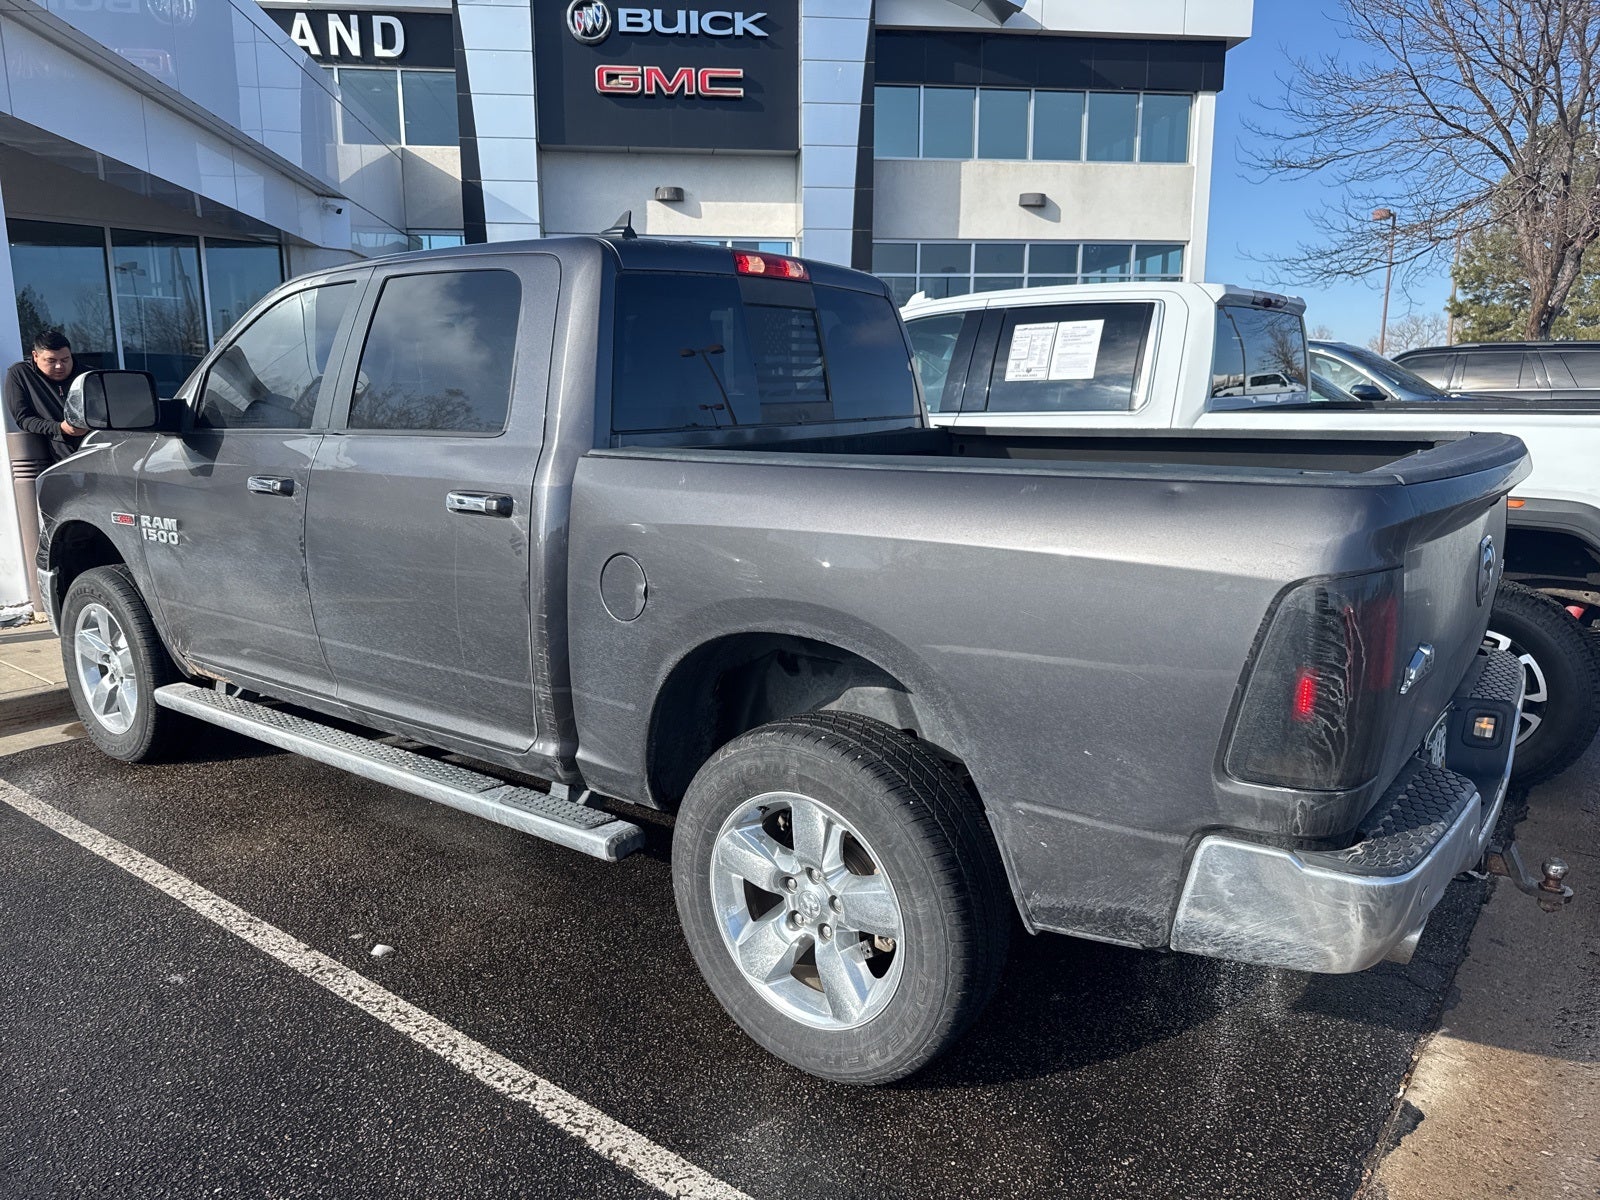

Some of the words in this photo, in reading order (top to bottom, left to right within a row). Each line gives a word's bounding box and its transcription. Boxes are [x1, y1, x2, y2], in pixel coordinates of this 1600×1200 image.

[290, 12, 405, 57] AND
[617, 7, 769, 37] BUICK
[595, 65, 744, 97] GMC
[140, 514, 178, 532] RAM
[141, 528, 179, 545] 1500
